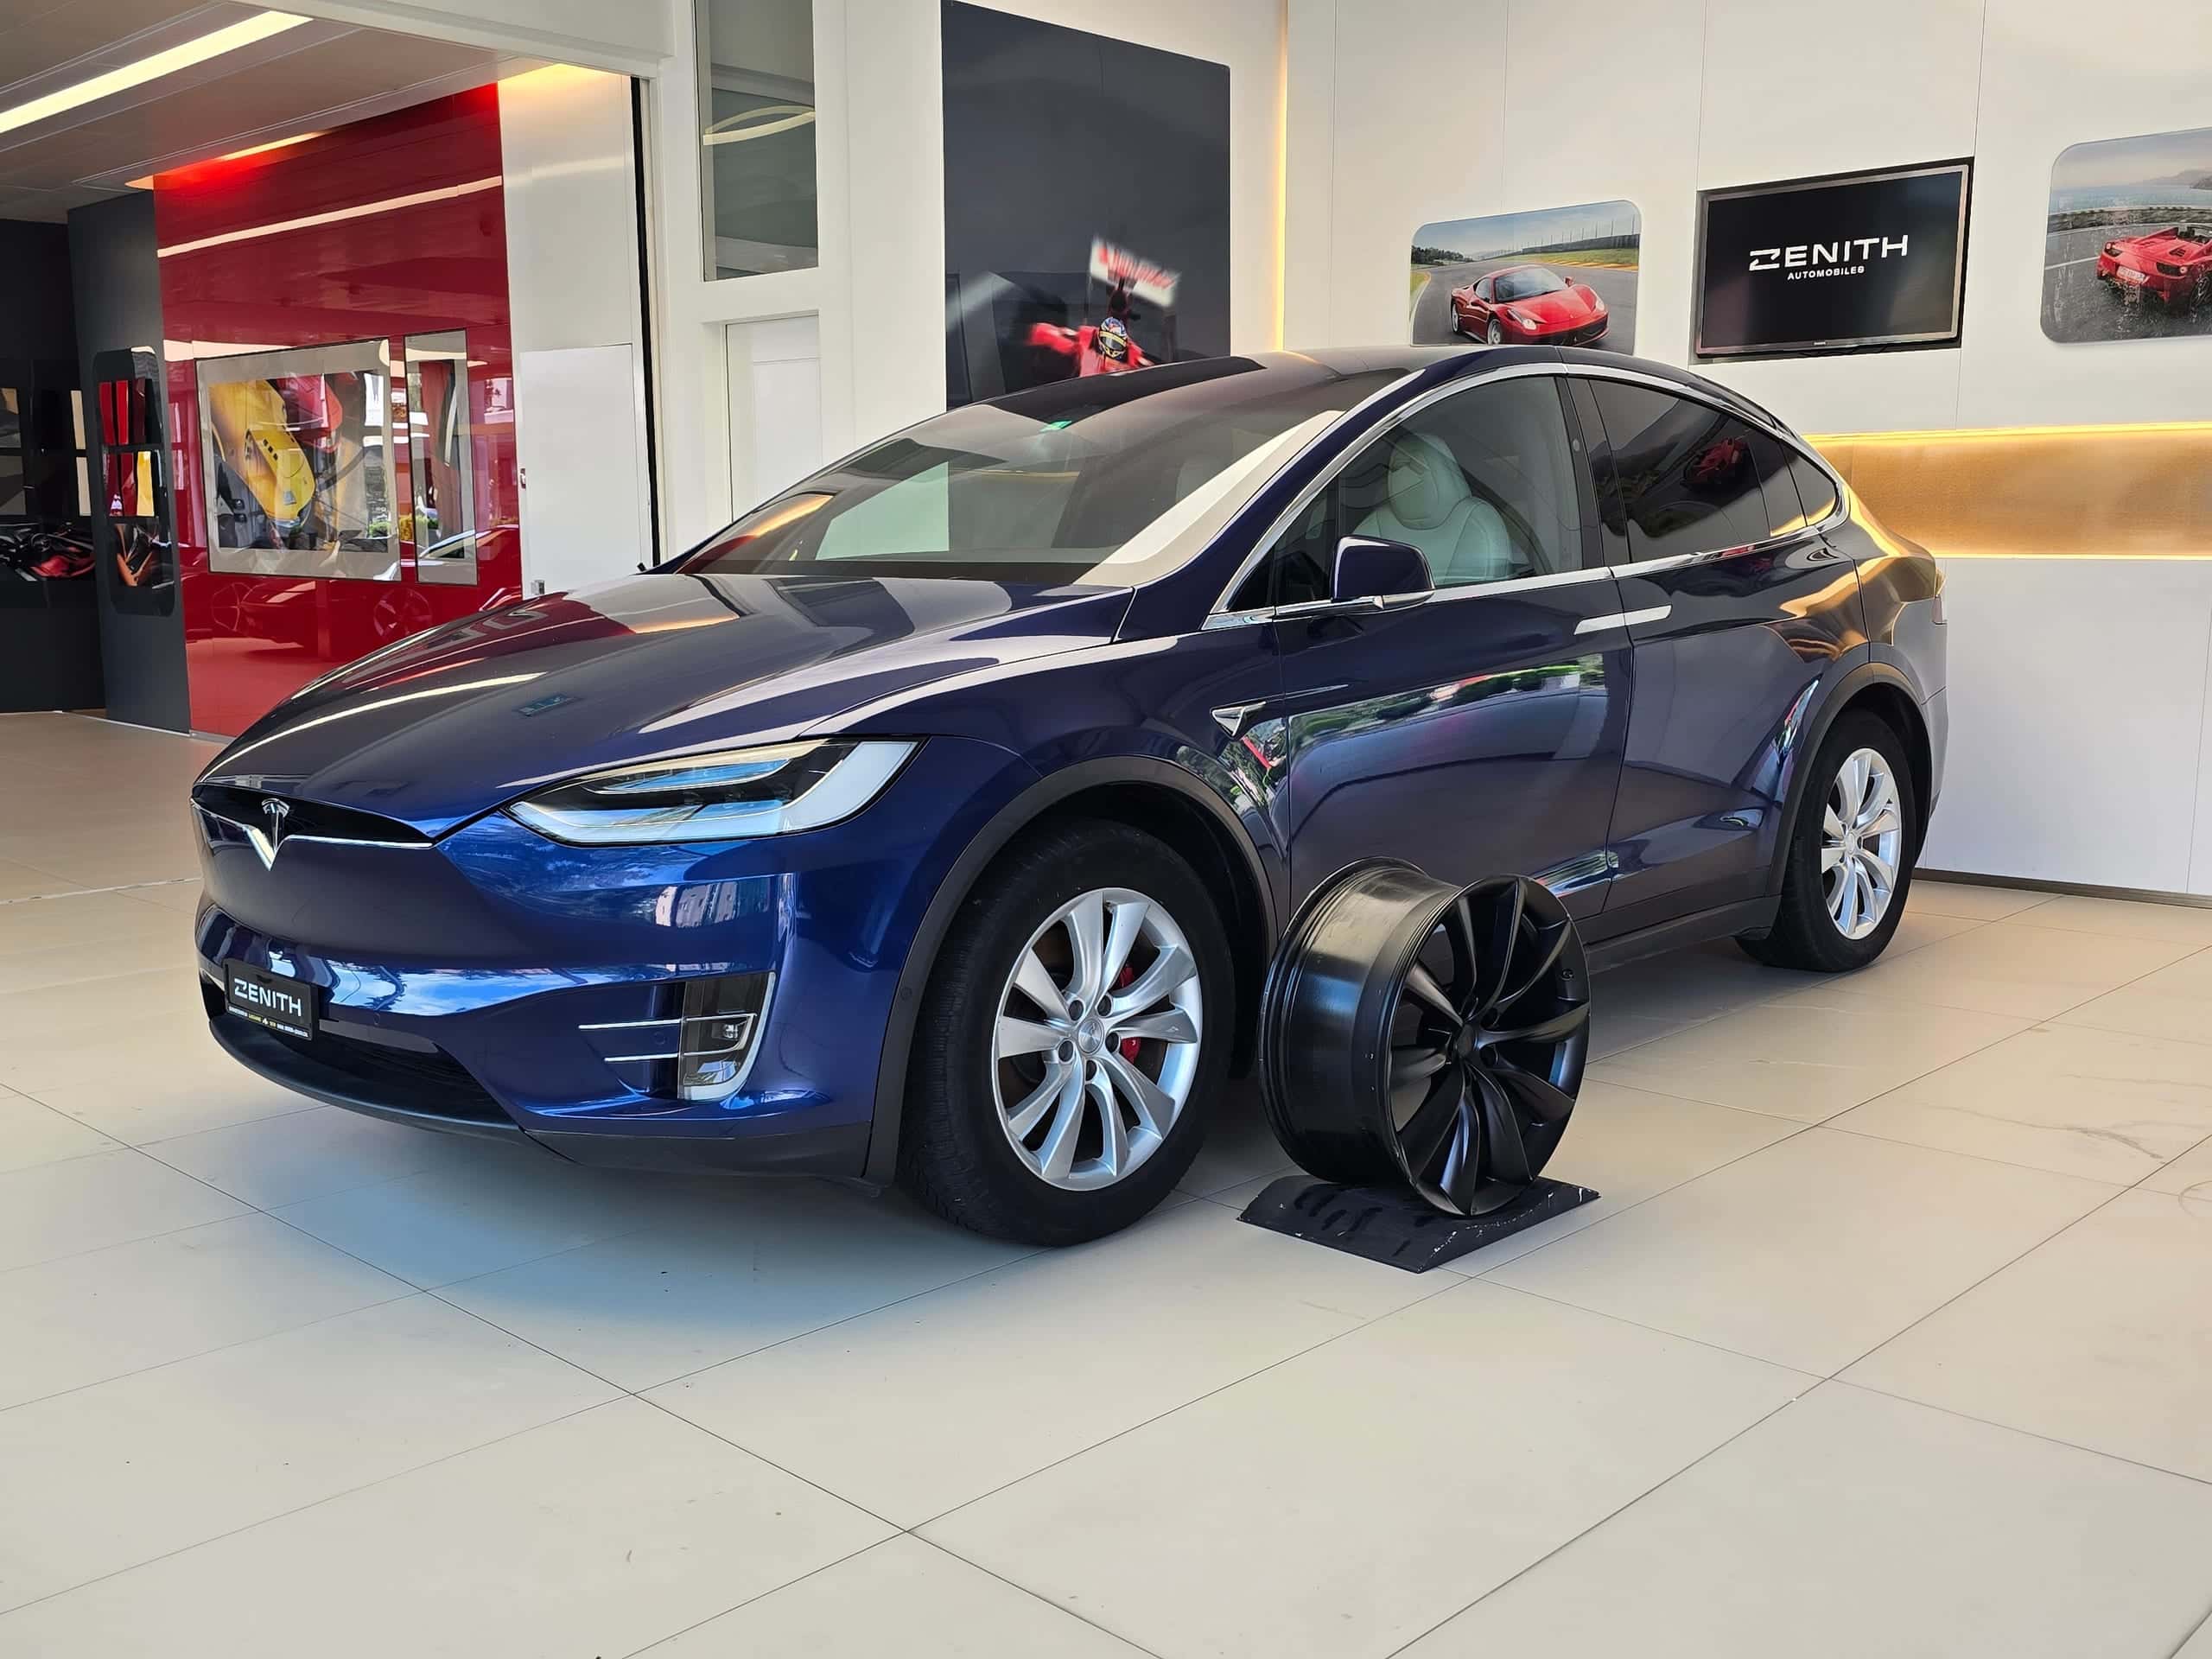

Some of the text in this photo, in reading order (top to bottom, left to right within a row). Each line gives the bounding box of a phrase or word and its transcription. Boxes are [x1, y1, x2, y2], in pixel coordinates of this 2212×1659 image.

[1749, 234, 1909, 271] ZENITH
[1787, 265, 1866, 281] AUTOMOBILES
[234, 977, 302, 1017] ZENITH
